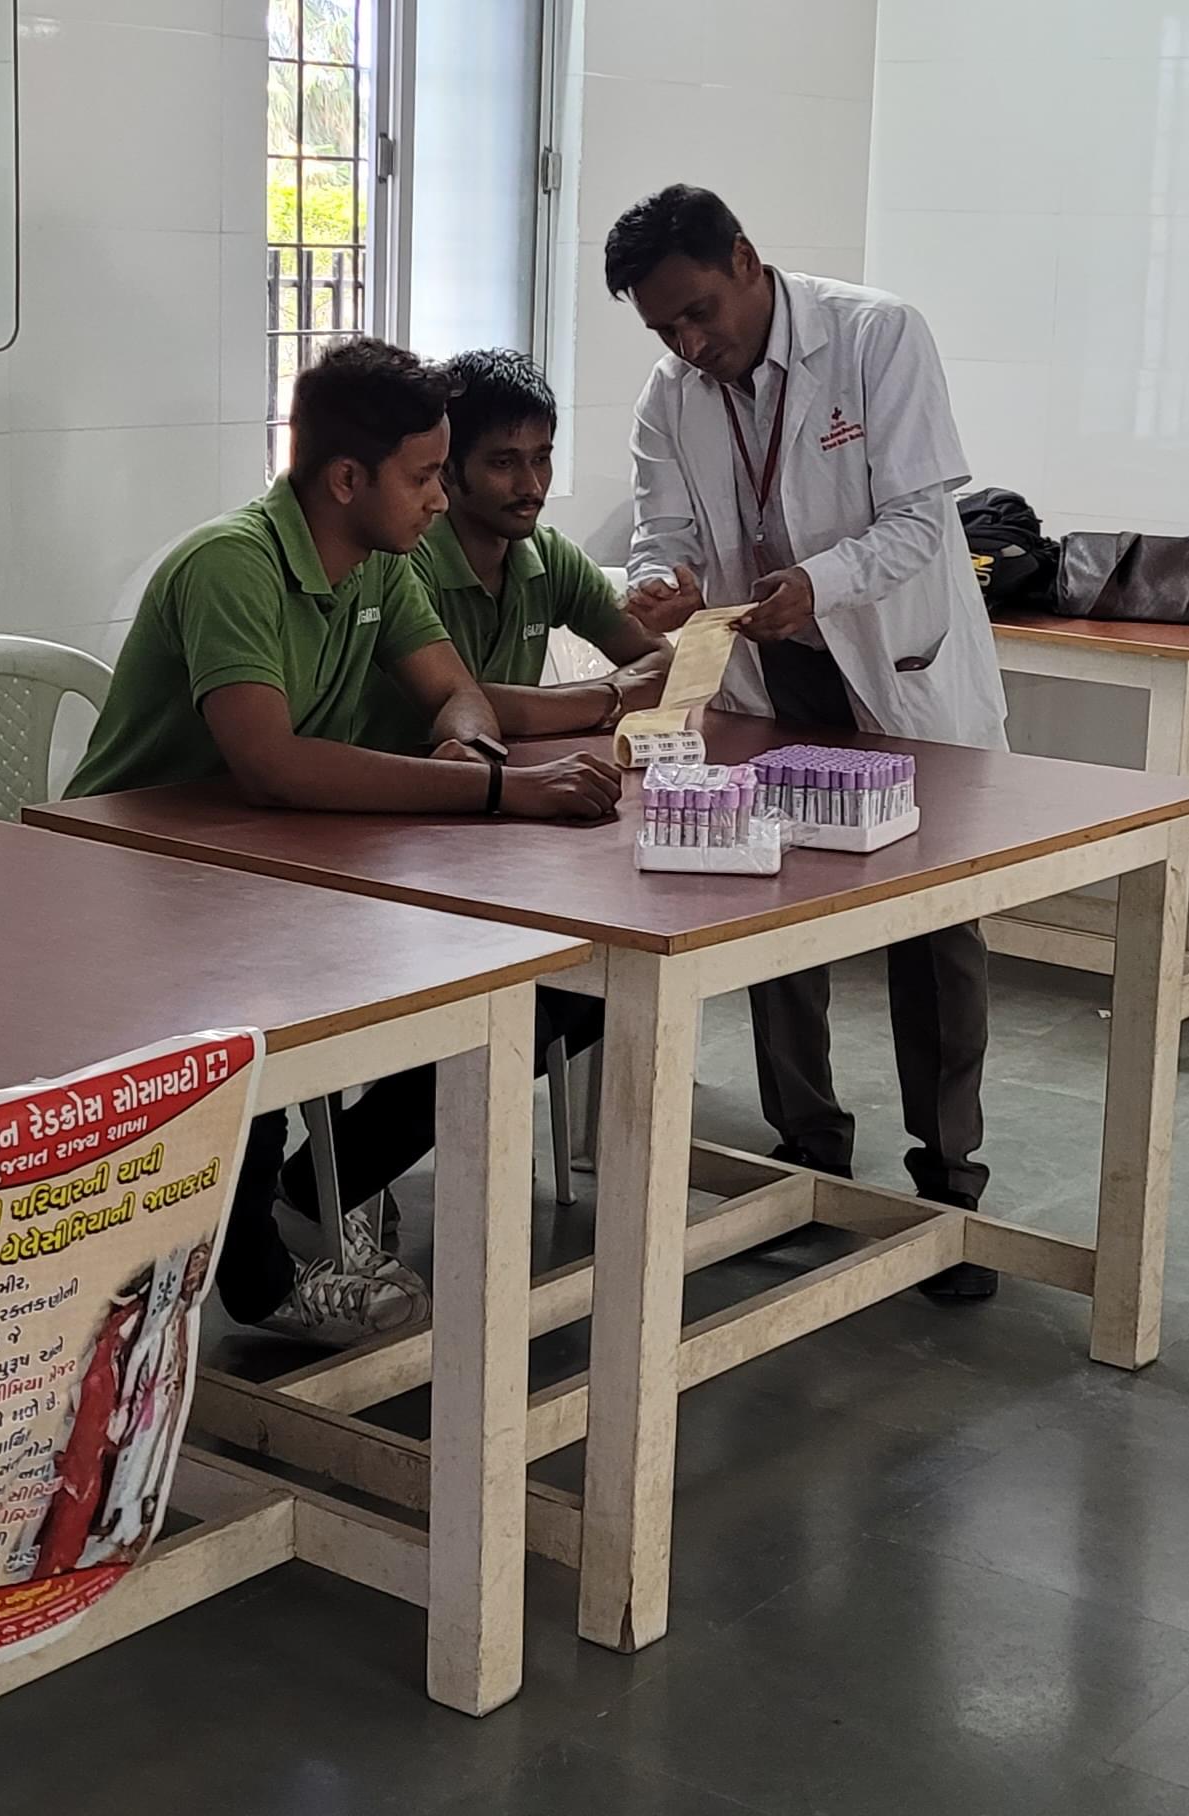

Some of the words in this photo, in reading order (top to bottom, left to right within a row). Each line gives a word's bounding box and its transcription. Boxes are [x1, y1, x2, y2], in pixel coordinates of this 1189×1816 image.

[113, 1056, 198, 1113] સોસાયટી
[57, 1132, 99, 1158] રાજ્ય
[107, 1116, 147, 1140] શાખા
[11, 1162, 110, 1221] પરિવારની
[117, 1143, 164, 1184] ચાવી
[0, 1191, 136, 1265] થેલેસીમિયાની
[143, 1157, 220, 1213] જાણકારી
[8, 1326, 21, 1343] જે
